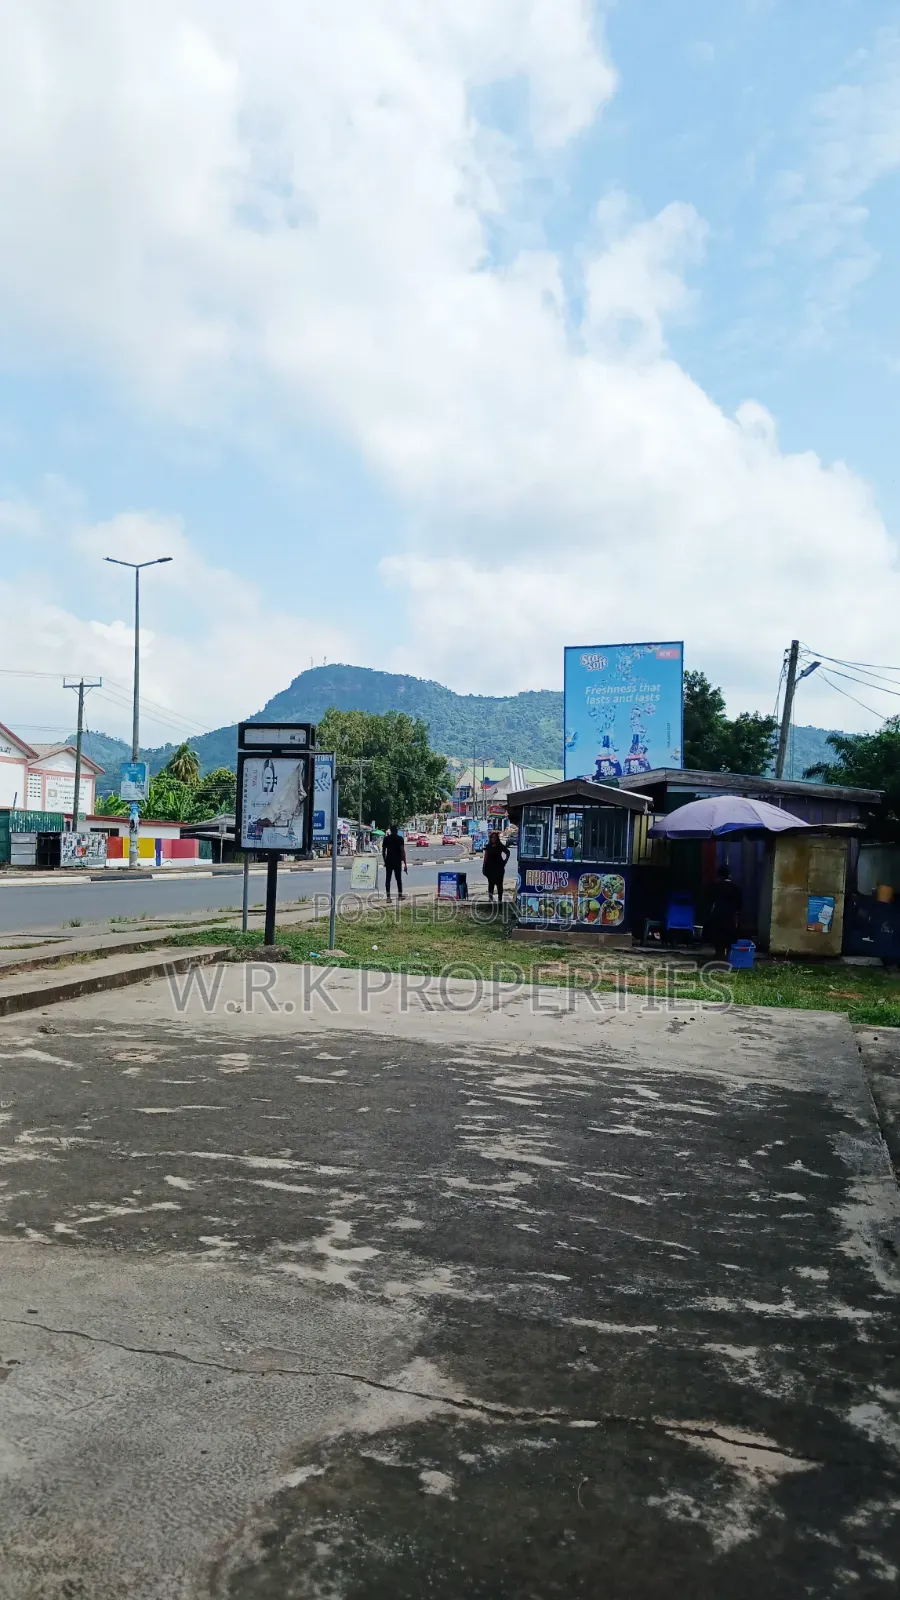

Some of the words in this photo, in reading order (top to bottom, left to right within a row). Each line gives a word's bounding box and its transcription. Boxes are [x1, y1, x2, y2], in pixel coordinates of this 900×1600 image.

[585, 685, 637, 695] Freshness
[639, 683, 661, 692] that
[586, 695, 611, 704] lasts
[613, 694, 633, 703] and
[635, 693, 660, 702] lasts
[525, 869, 569, 888] RHODA'S
